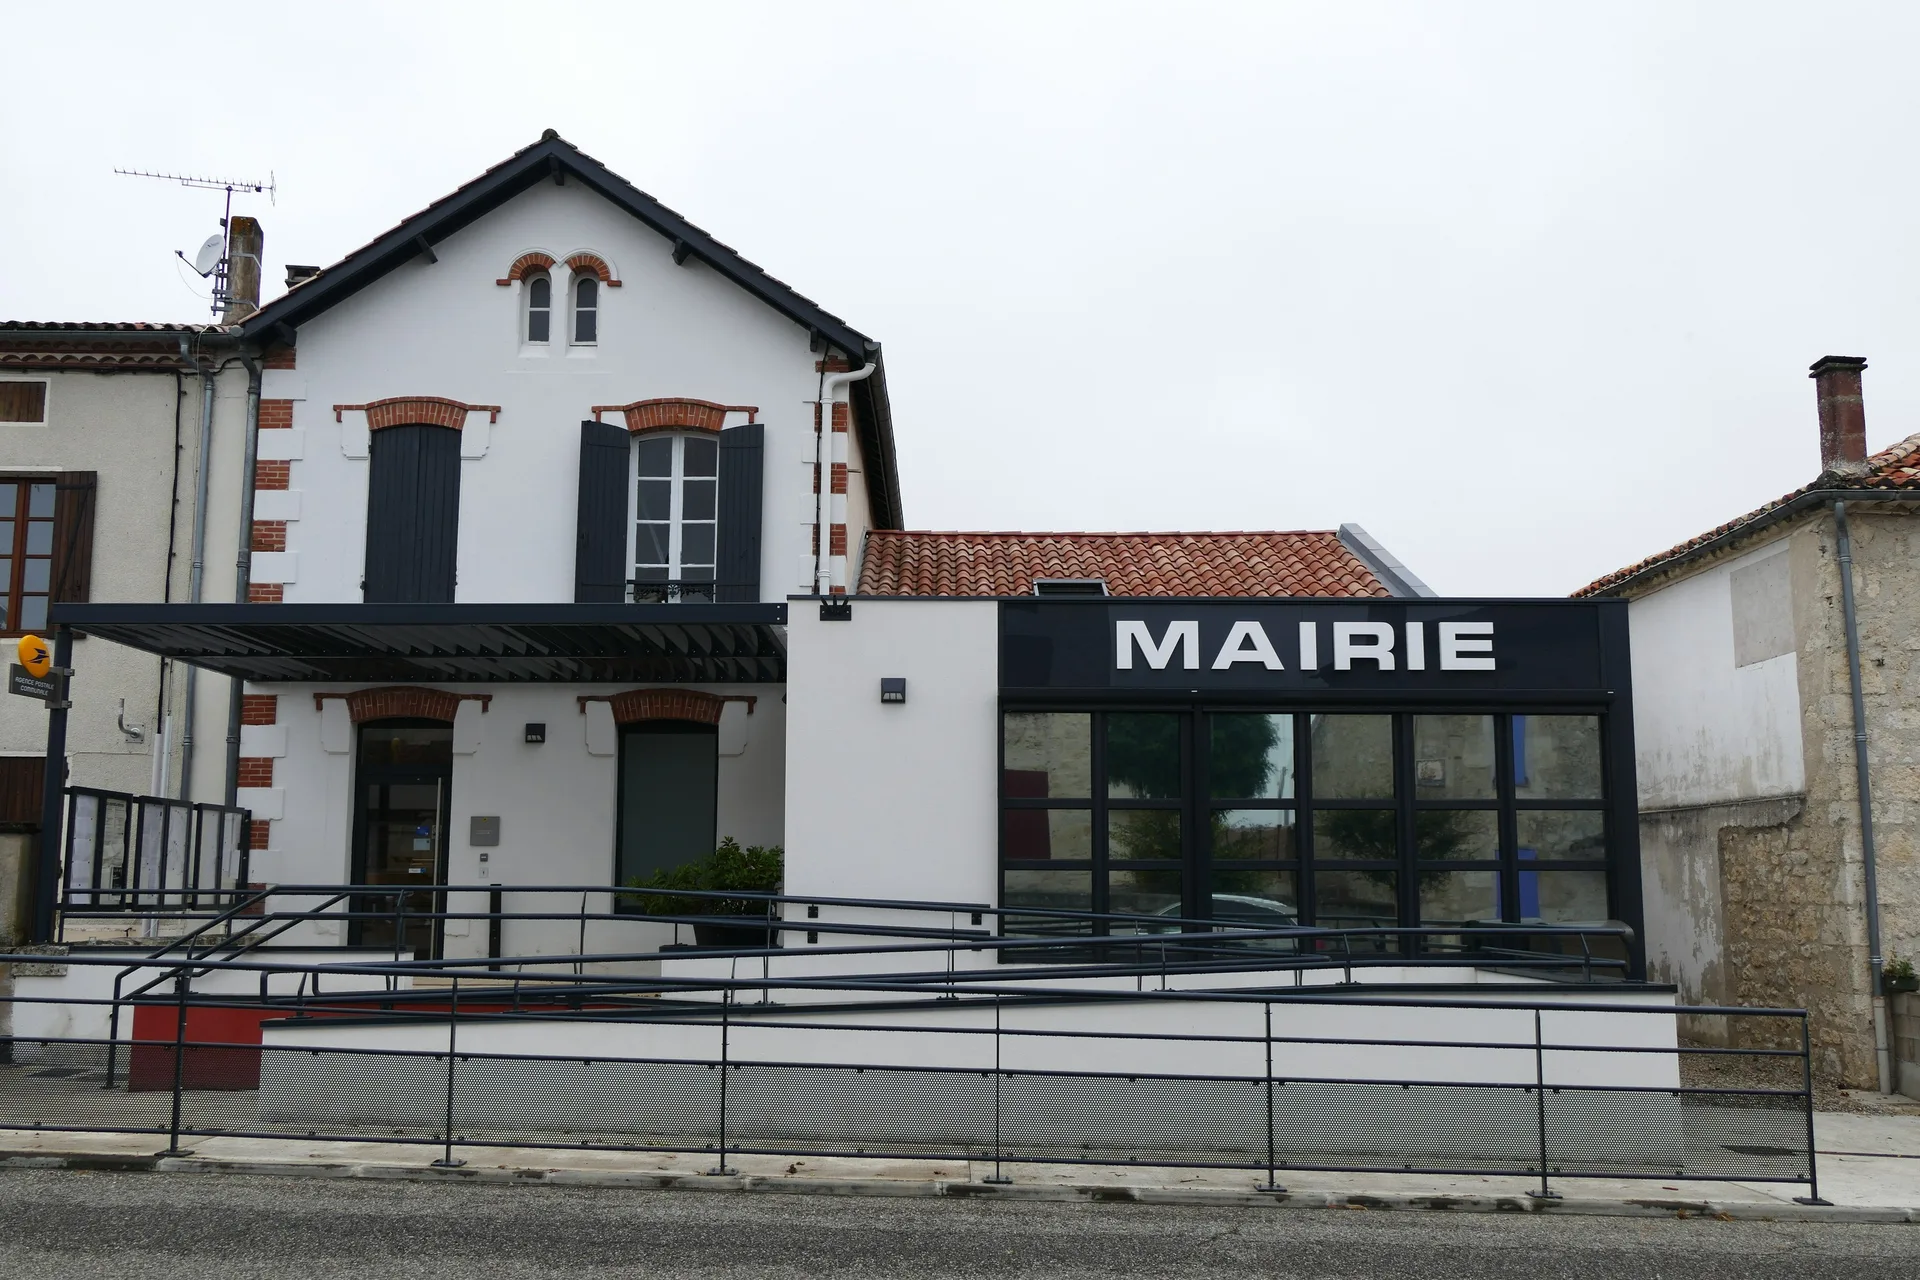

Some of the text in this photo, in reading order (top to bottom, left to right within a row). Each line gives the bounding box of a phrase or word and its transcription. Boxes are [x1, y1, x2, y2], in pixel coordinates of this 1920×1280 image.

[1116, 620, 1496, 671] MAIRIE
[15, 676, 54, 690] AGENCE POSTALE
[20, 685, 48, 696] COMMUNALE
